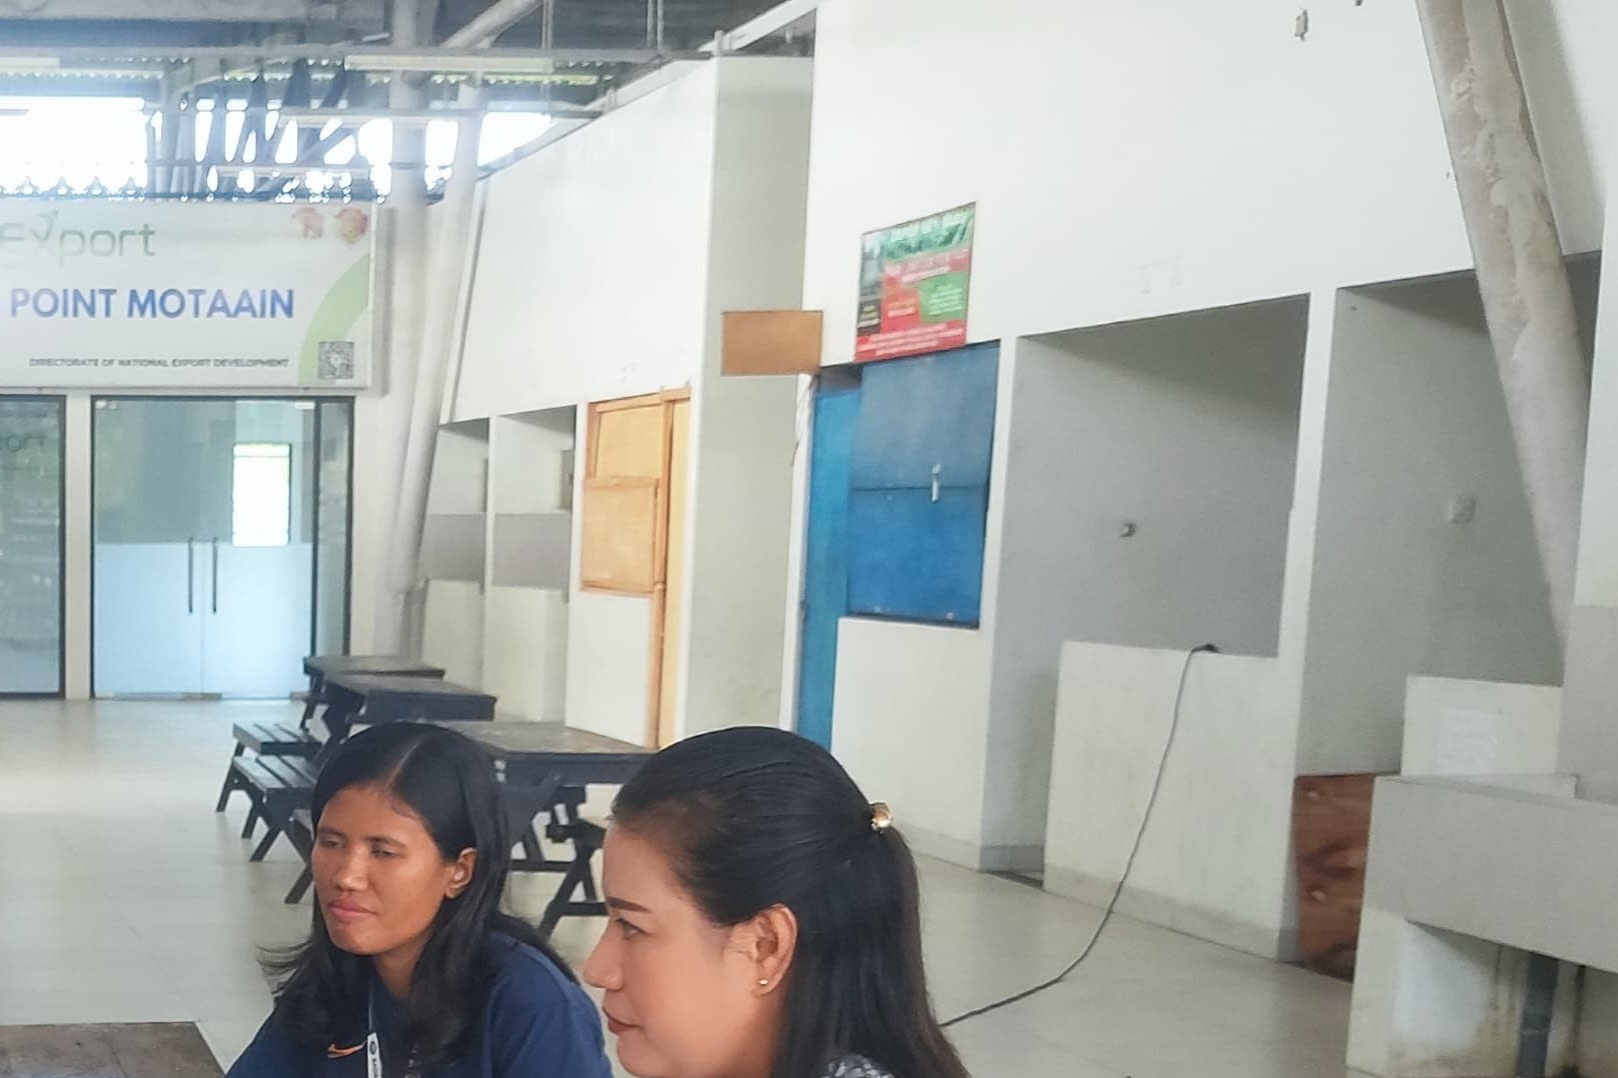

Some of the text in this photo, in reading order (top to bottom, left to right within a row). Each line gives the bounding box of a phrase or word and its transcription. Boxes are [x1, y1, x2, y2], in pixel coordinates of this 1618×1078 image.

[10, 287, 117, 318] POINT
[127, 288, 294, 319] MOTAAIN
[29, 358, 290, 367] DIRECTORATE OF NATIONAL EXPORT DEVELOPMENT
